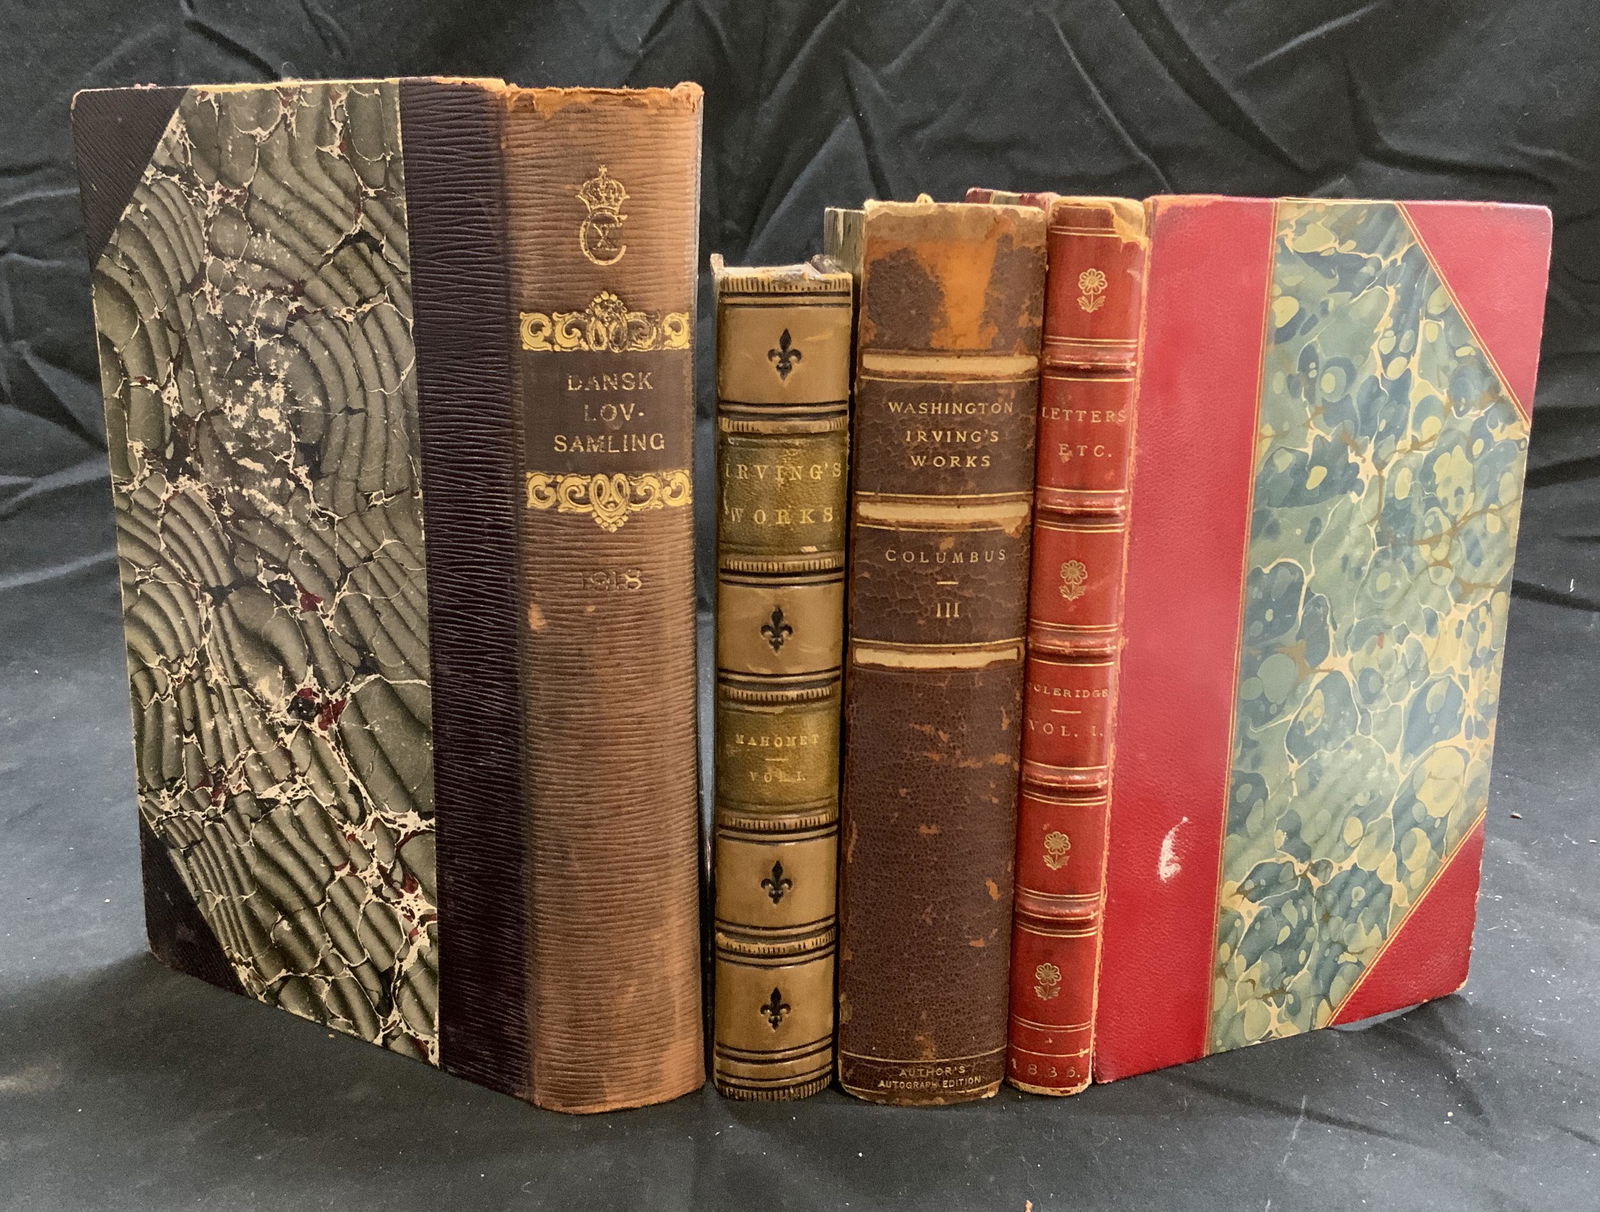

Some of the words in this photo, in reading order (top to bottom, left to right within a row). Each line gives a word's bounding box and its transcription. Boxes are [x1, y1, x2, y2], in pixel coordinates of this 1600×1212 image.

[567, 372, 653, 391] DANSK
[888, 402, 1014, 415] WASHINGTON
[1042, 406, 1127, 424] LETTERS
[554, 433, 665, 453] SAMLING
[905, 430, 999, 443] IRVING'S
[1058, 443, 1112, 458] ETC.
[911, 455, 991, 468] WORKS
[725, 462, 842, 480] IRVING'S
[730, 507, 834, 524] WORKS
[885, 549, 1006, 564] COLUMBUS
[936, 603, 960, 618] III
[1027, 682, 1109, 698] OLERIDGE
[1091, 725, 1104, 737] I.
[735, 733, 819, 748] MAHOMET
[899, 1065, 966, 1078] AUTHOR'S
[877, 1079, 938, 1090] AUTOGRAPH
[942, 1075, 981, 1089] EDITION
